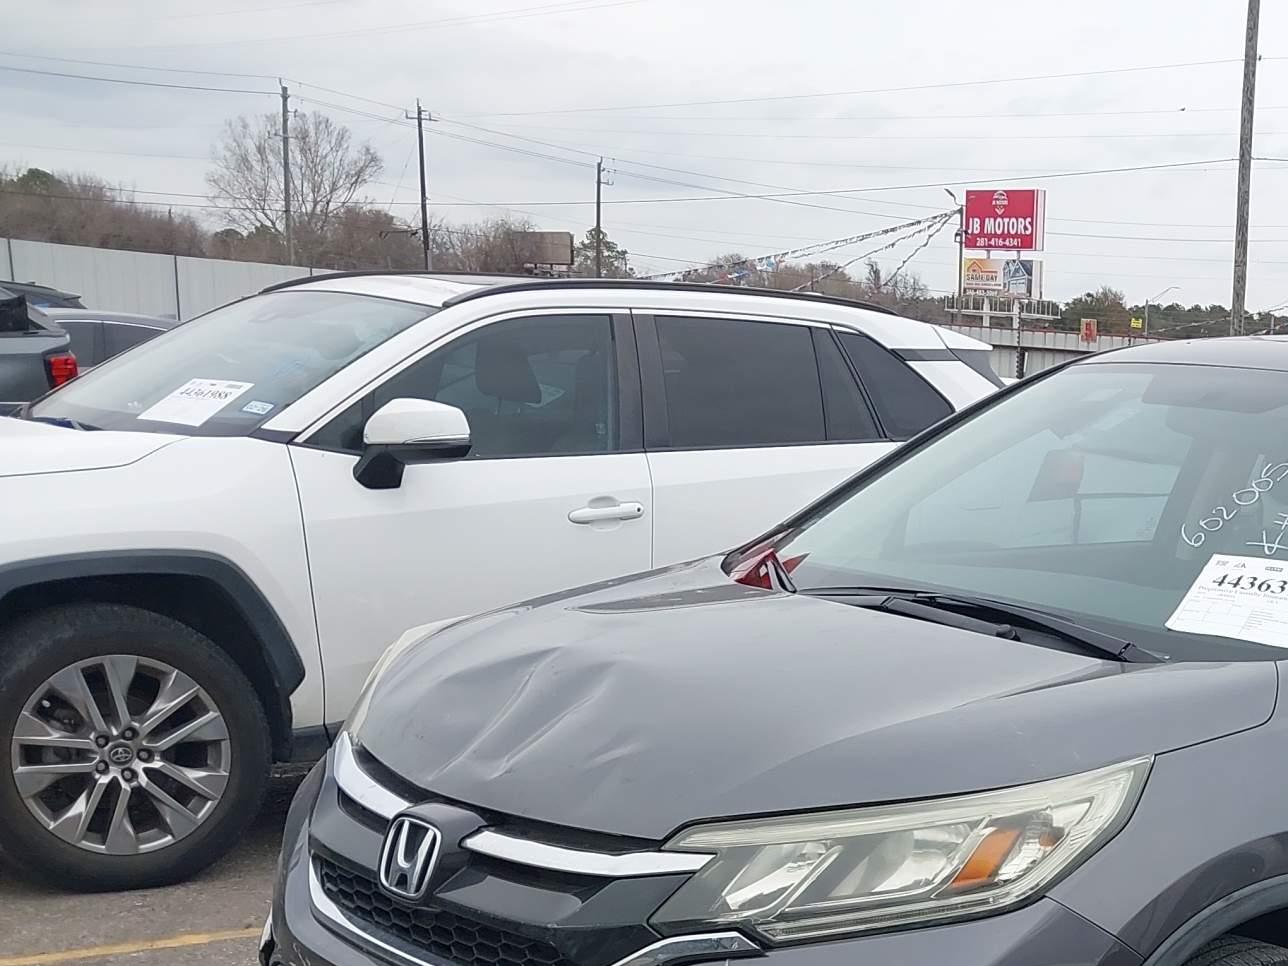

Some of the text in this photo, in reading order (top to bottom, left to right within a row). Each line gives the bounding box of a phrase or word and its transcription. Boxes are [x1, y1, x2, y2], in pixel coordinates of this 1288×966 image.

[967, 217, 1032, 236] JB MOTORS
[976, 237, 1022, 248] 281-416-4341
